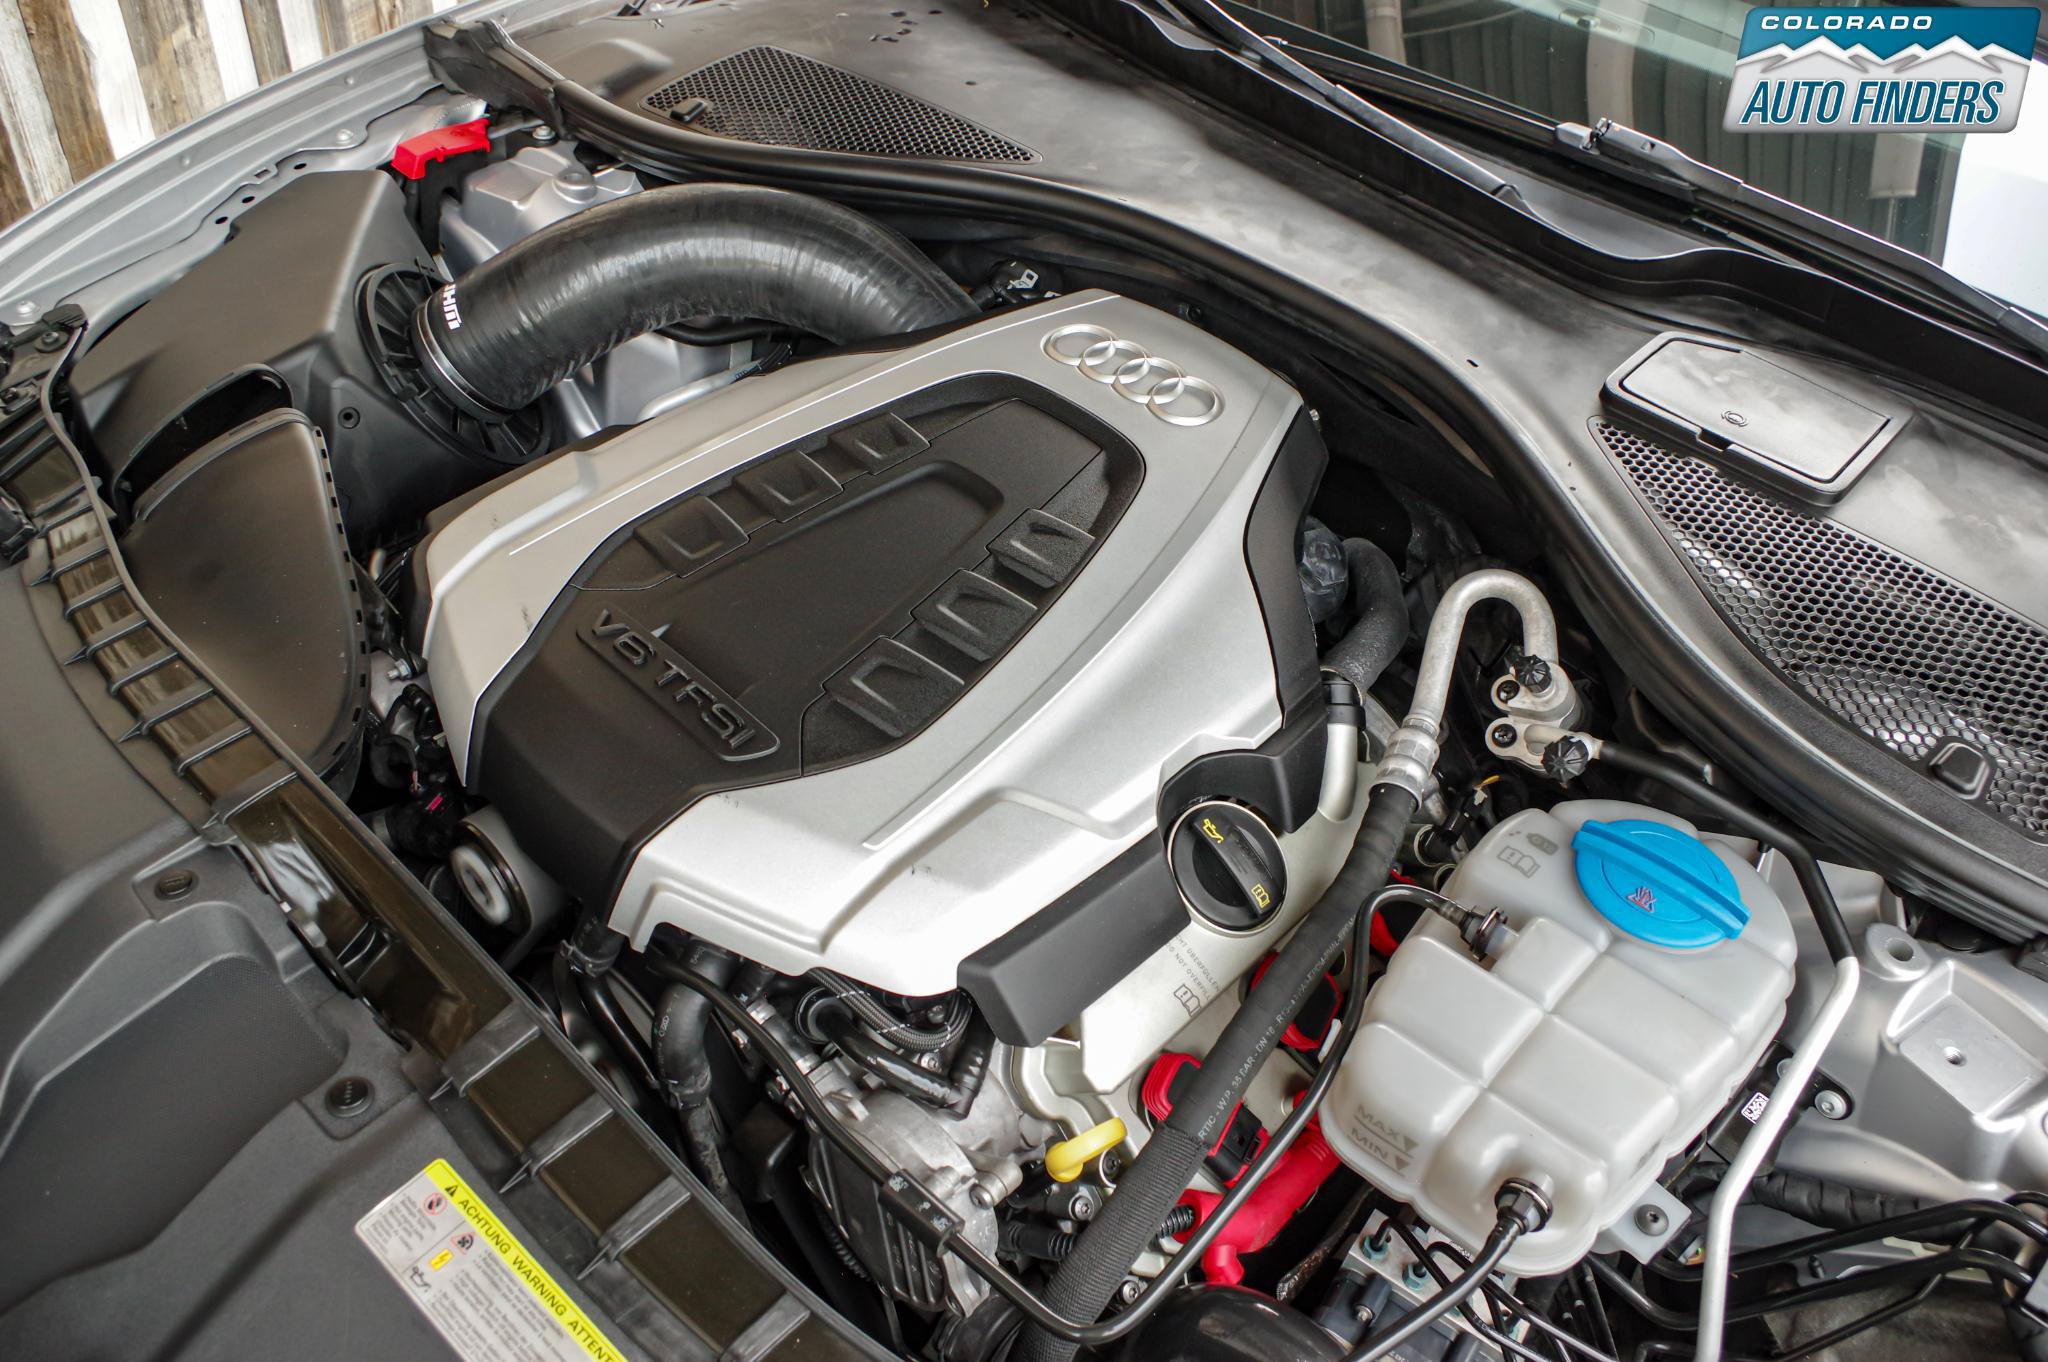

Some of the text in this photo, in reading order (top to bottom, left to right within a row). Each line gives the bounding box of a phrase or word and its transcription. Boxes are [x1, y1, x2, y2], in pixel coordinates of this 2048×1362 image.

[591, 608, 756, 750] V6 TFSI
[1351, 1127, 1388, 1160] MIN
[1358, 1104, 1400, 1140] MAX
[458, 1199, 512, 1255] ACHTUNG
[512, 1255, 567, 1317] WARNING
